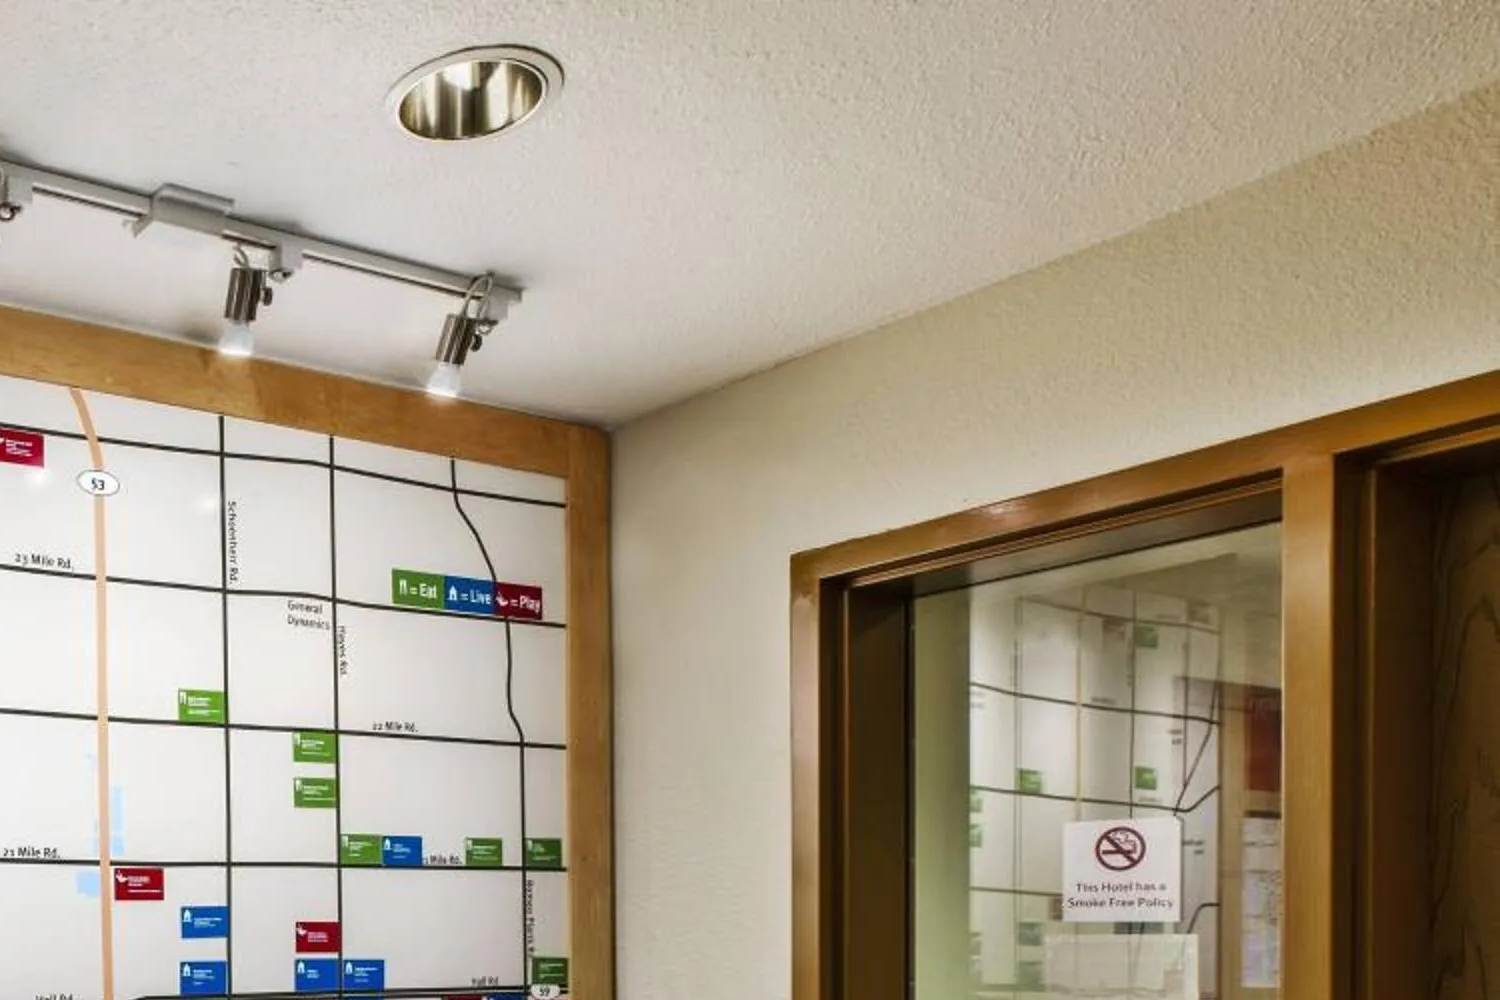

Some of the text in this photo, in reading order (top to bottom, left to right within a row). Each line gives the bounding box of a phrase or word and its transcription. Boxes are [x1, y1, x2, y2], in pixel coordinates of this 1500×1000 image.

[91, 478, 106, 491] 53
[30, 553, 55, 569] Mile
[419, 583, 438, 599] Eat
[469, 589, 492, 605] Live
[519, 595, 541, 614] Play
[17, 845, 41, 859] Mile
[1076, 882, 1099, 893] This
[1101, 882, 1133, 893] Hotel
[1135, 882, 1156, 891] has
[1067, 897, 1173, 909] Smoke Free Policy
